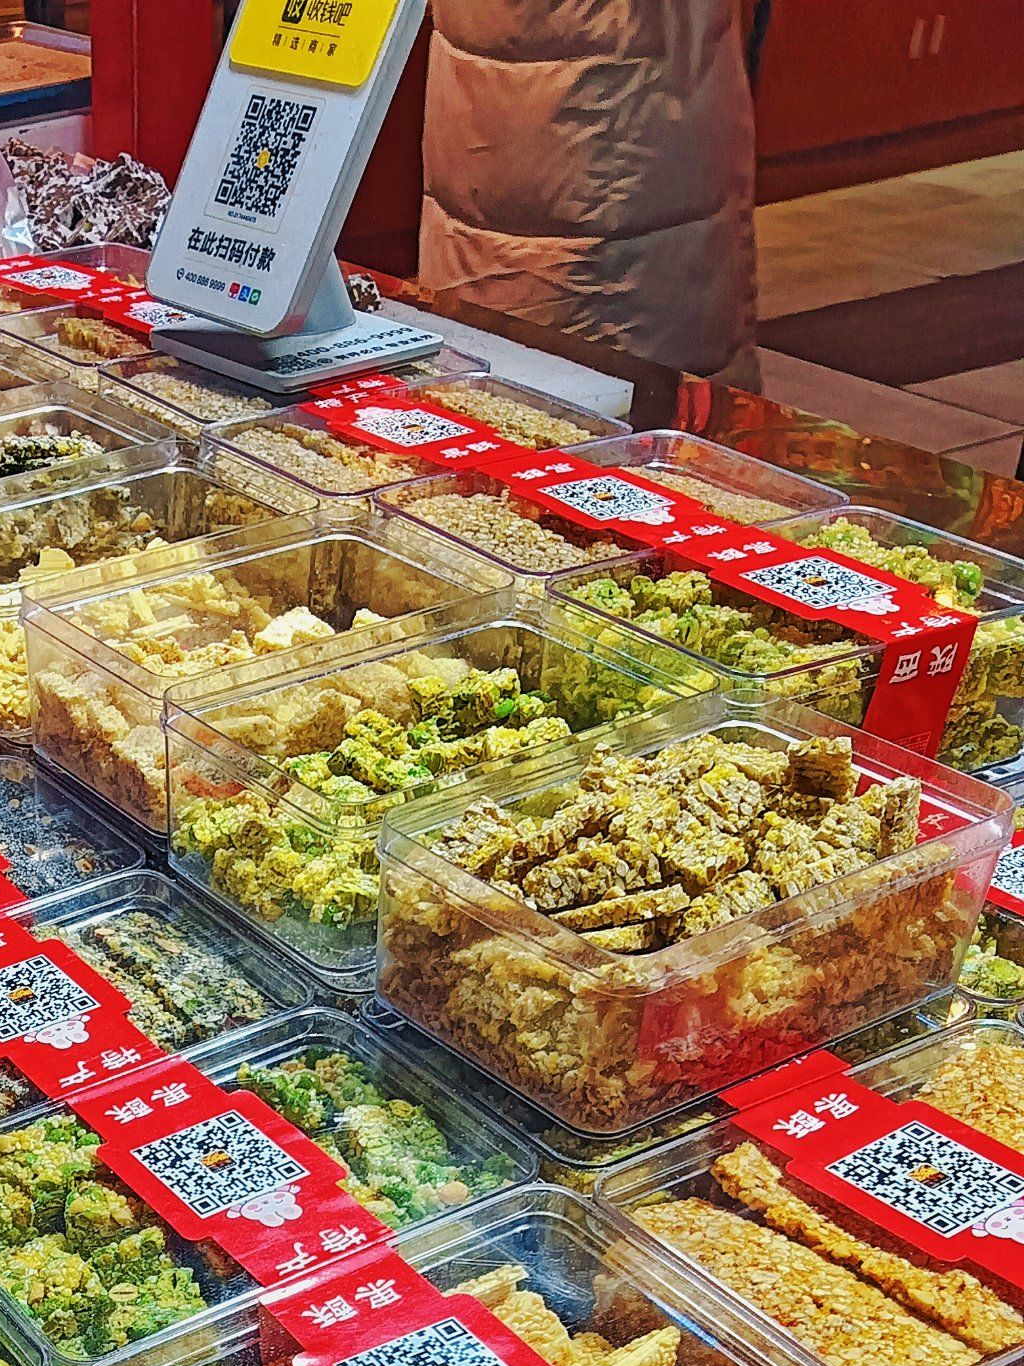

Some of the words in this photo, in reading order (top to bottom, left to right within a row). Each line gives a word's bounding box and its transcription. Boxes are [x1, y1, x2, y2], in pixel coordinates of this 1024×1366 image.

[307, 0, 353, 26] 收钱吧
[187, 227, 276, 272] 在此扫码付款
[889, 642, 959, 684] 陕西
[59, 1045, 143, 1088] 特产
[103, 1081, 193, 1124] 果酥
[772, 1092, 860, 1139] 果酥
[274, 1223, 369, 1277] 特产
[300, 1278, 405, 1330] 果酥
